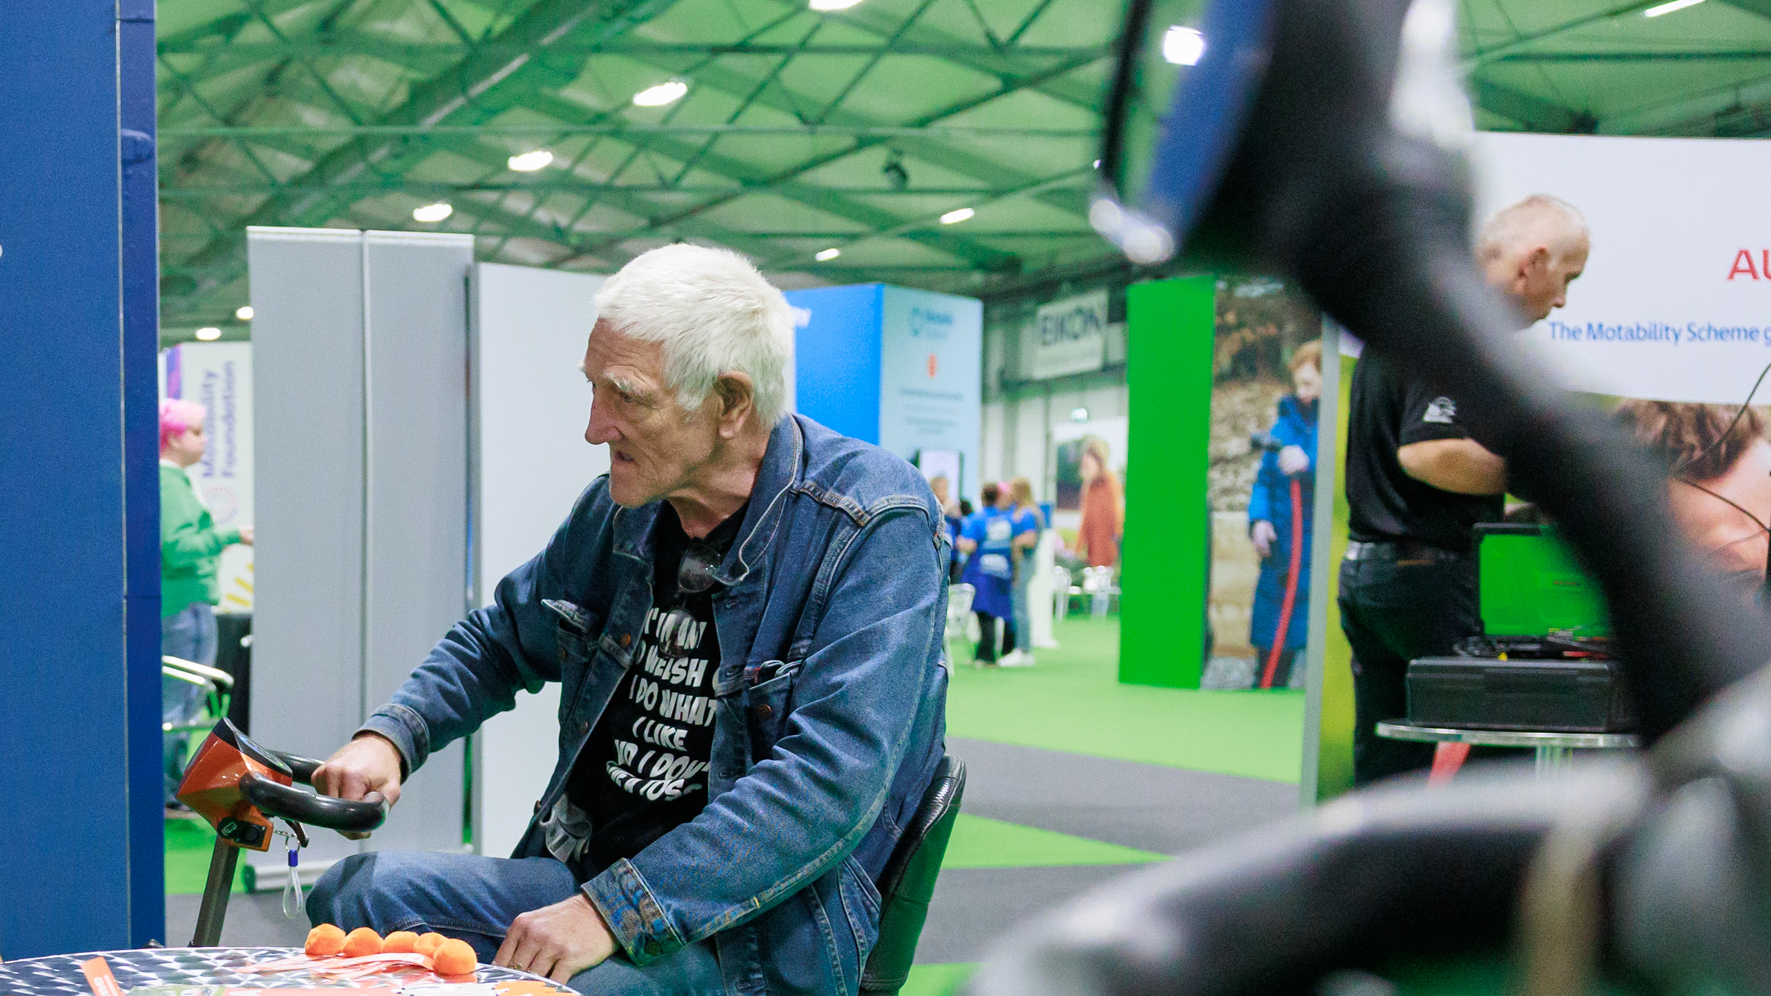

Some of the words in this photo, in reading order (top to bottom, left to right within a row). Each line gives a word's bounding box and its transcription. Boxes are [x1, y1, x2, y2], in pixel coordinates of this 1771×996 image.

[1548, 321, 1583, 341] The
[1586, 320, 1682, 346] Motability
[1686, 320, 1761, 342] Scheme
[644, 644, 709, 688] WELSH
[636, 677, 659, 712] DO
[660, 688, 717, 727] WHAT
[632, 716, 647, 738] I
[643, 720, 688, 752] LIKE
[637, 750, 657, 774] I
